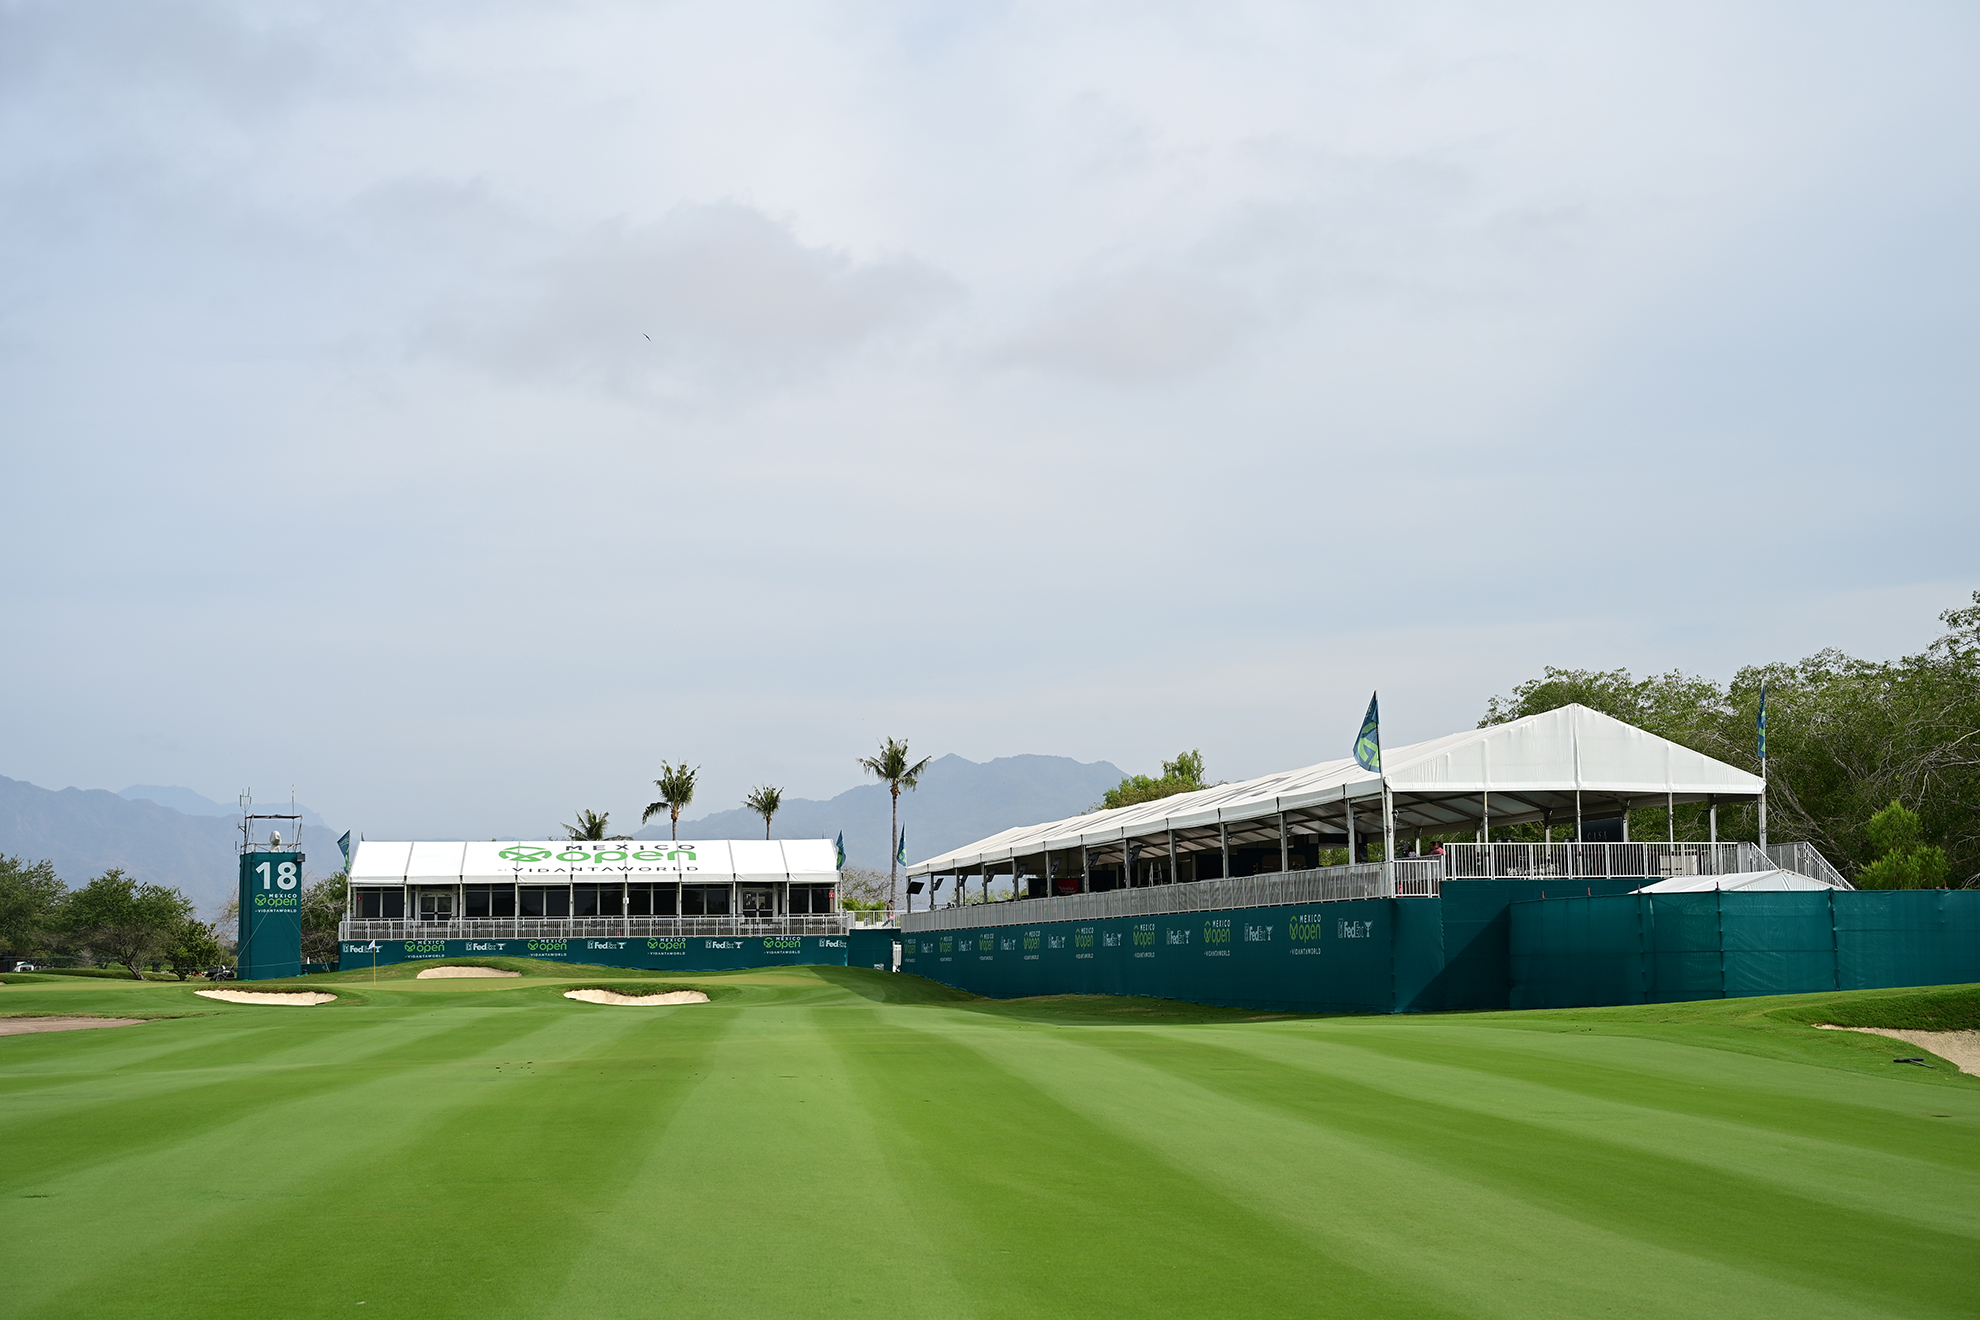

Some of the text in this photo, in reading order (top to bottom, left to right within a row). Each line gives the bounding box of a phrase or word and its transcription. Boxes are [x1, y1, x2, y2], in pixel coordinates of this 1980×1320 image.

[556, 850, 696, 863] open
[256, 862, 297, 890] 18
[267, 898, 297, 907] open
[1300, 914, 1321, 923] MEXICO
[1212, 928, 1230, 946] open
[1299, 924, 1321, 943] open
[774, 940, 800, 948] open
[1140, 932, 1155, 948] open
[416, 944, 445, 953] open
[540, 943, 567, 951] open
[659, 942, 686, 950] open
